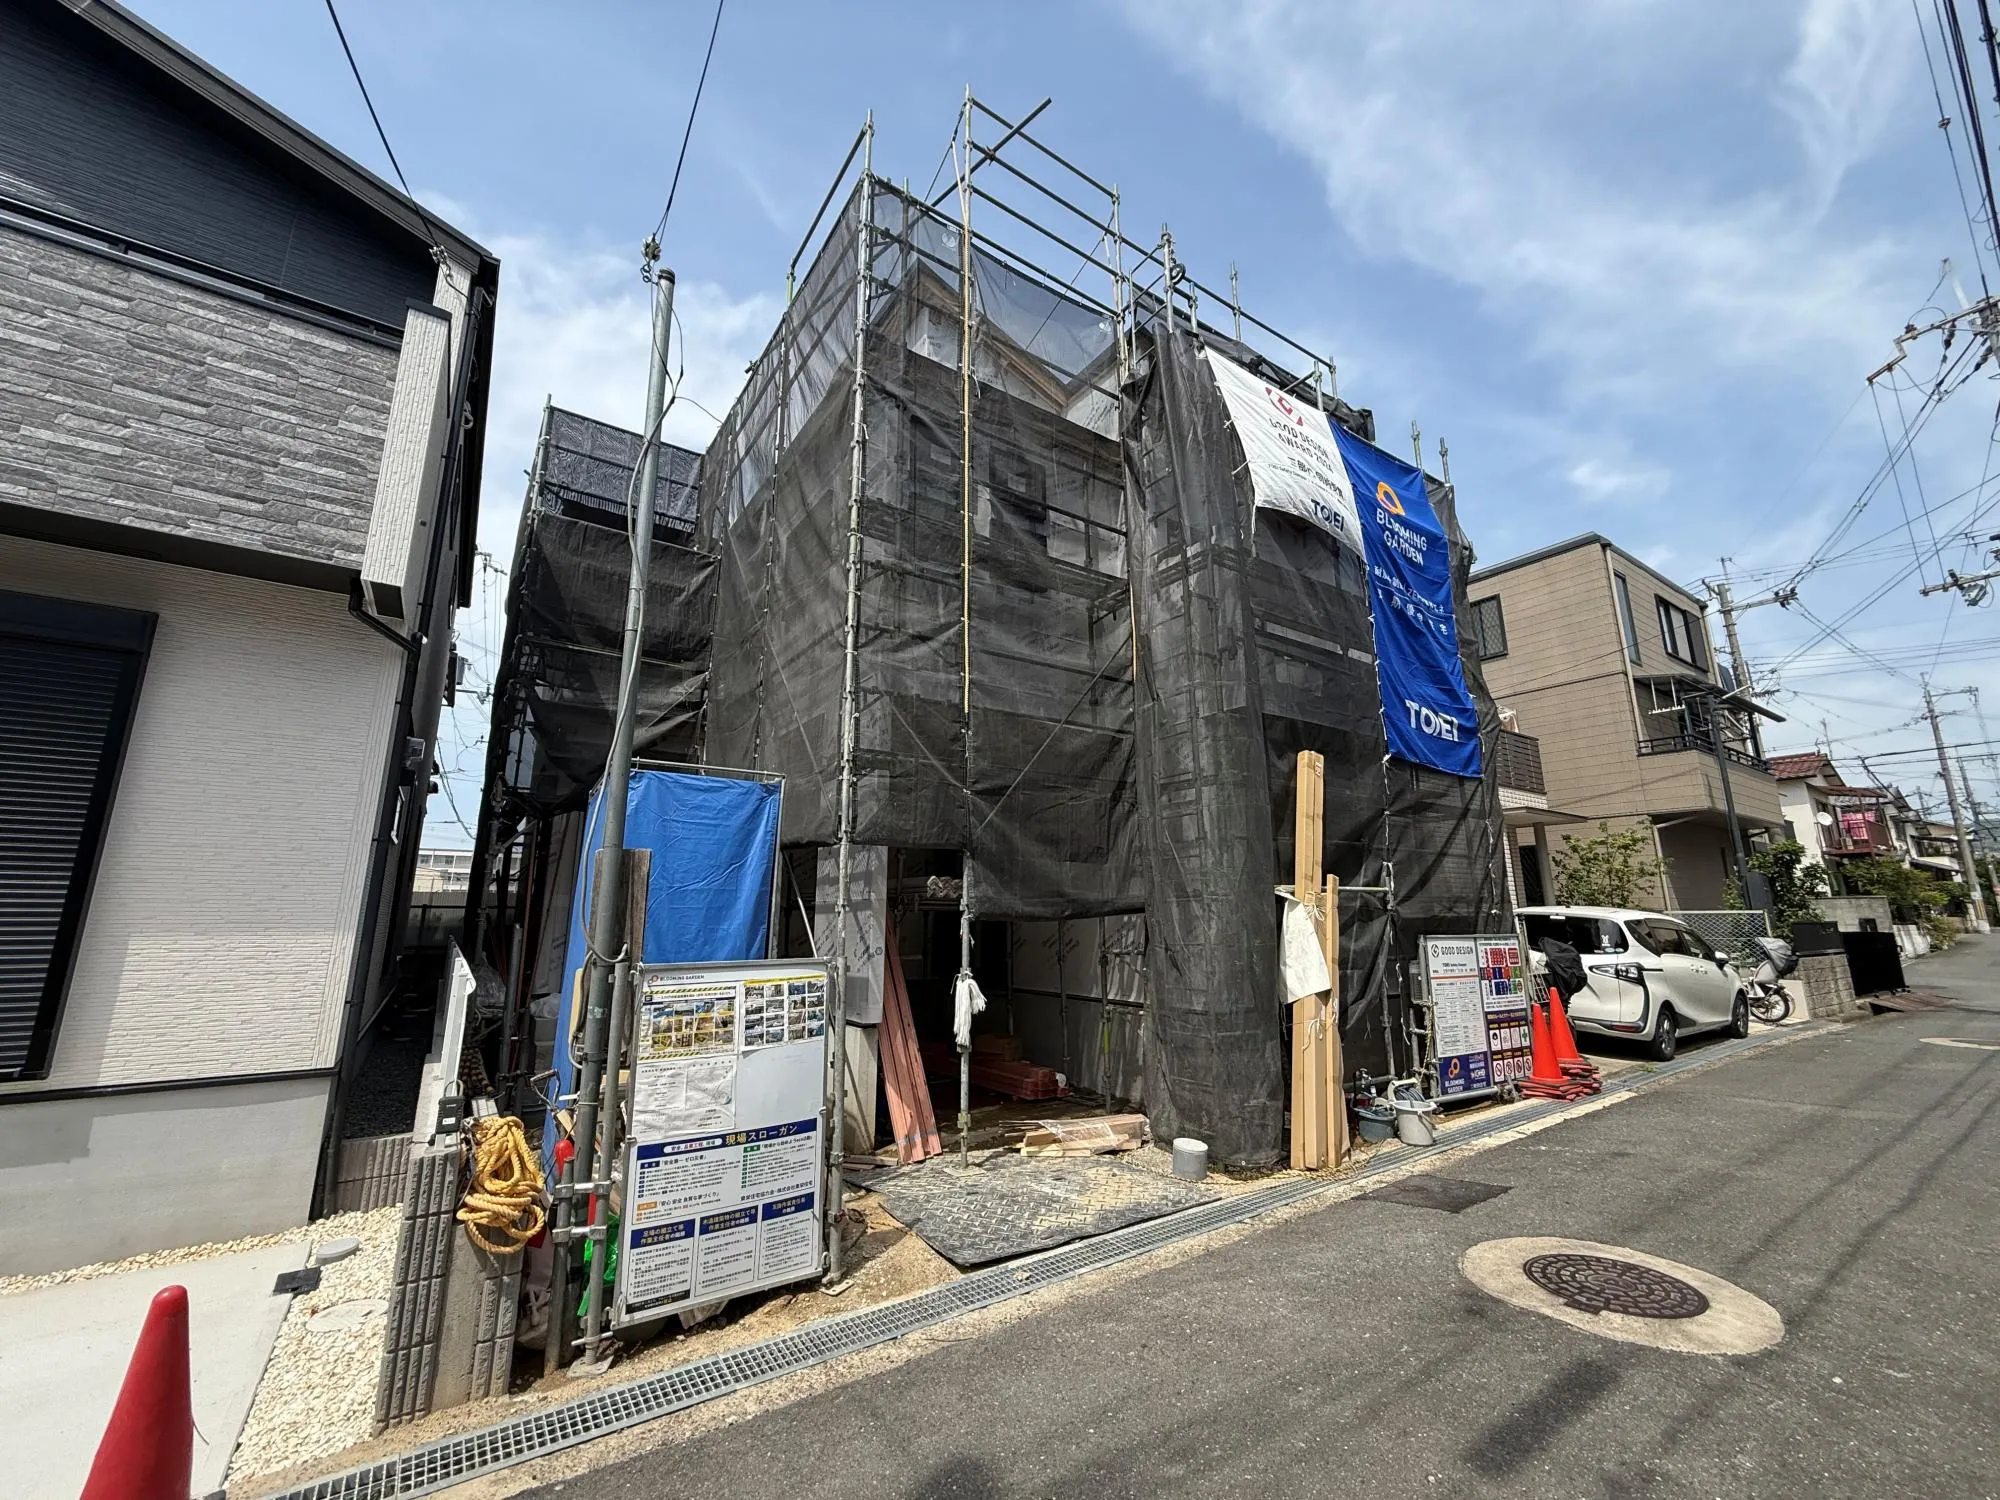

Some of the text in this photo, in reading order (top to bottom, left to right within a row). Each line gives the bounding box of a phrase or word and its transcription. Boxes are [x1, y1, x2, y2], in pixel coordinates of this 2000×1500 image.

[1311, 499, 1344, 532] TOEI
[1383, 531, 1424, 567] GARDEN
[1405, 699, 1459, 742] TOEI
[725, 1124, 798, 1146] 現場スローガン
